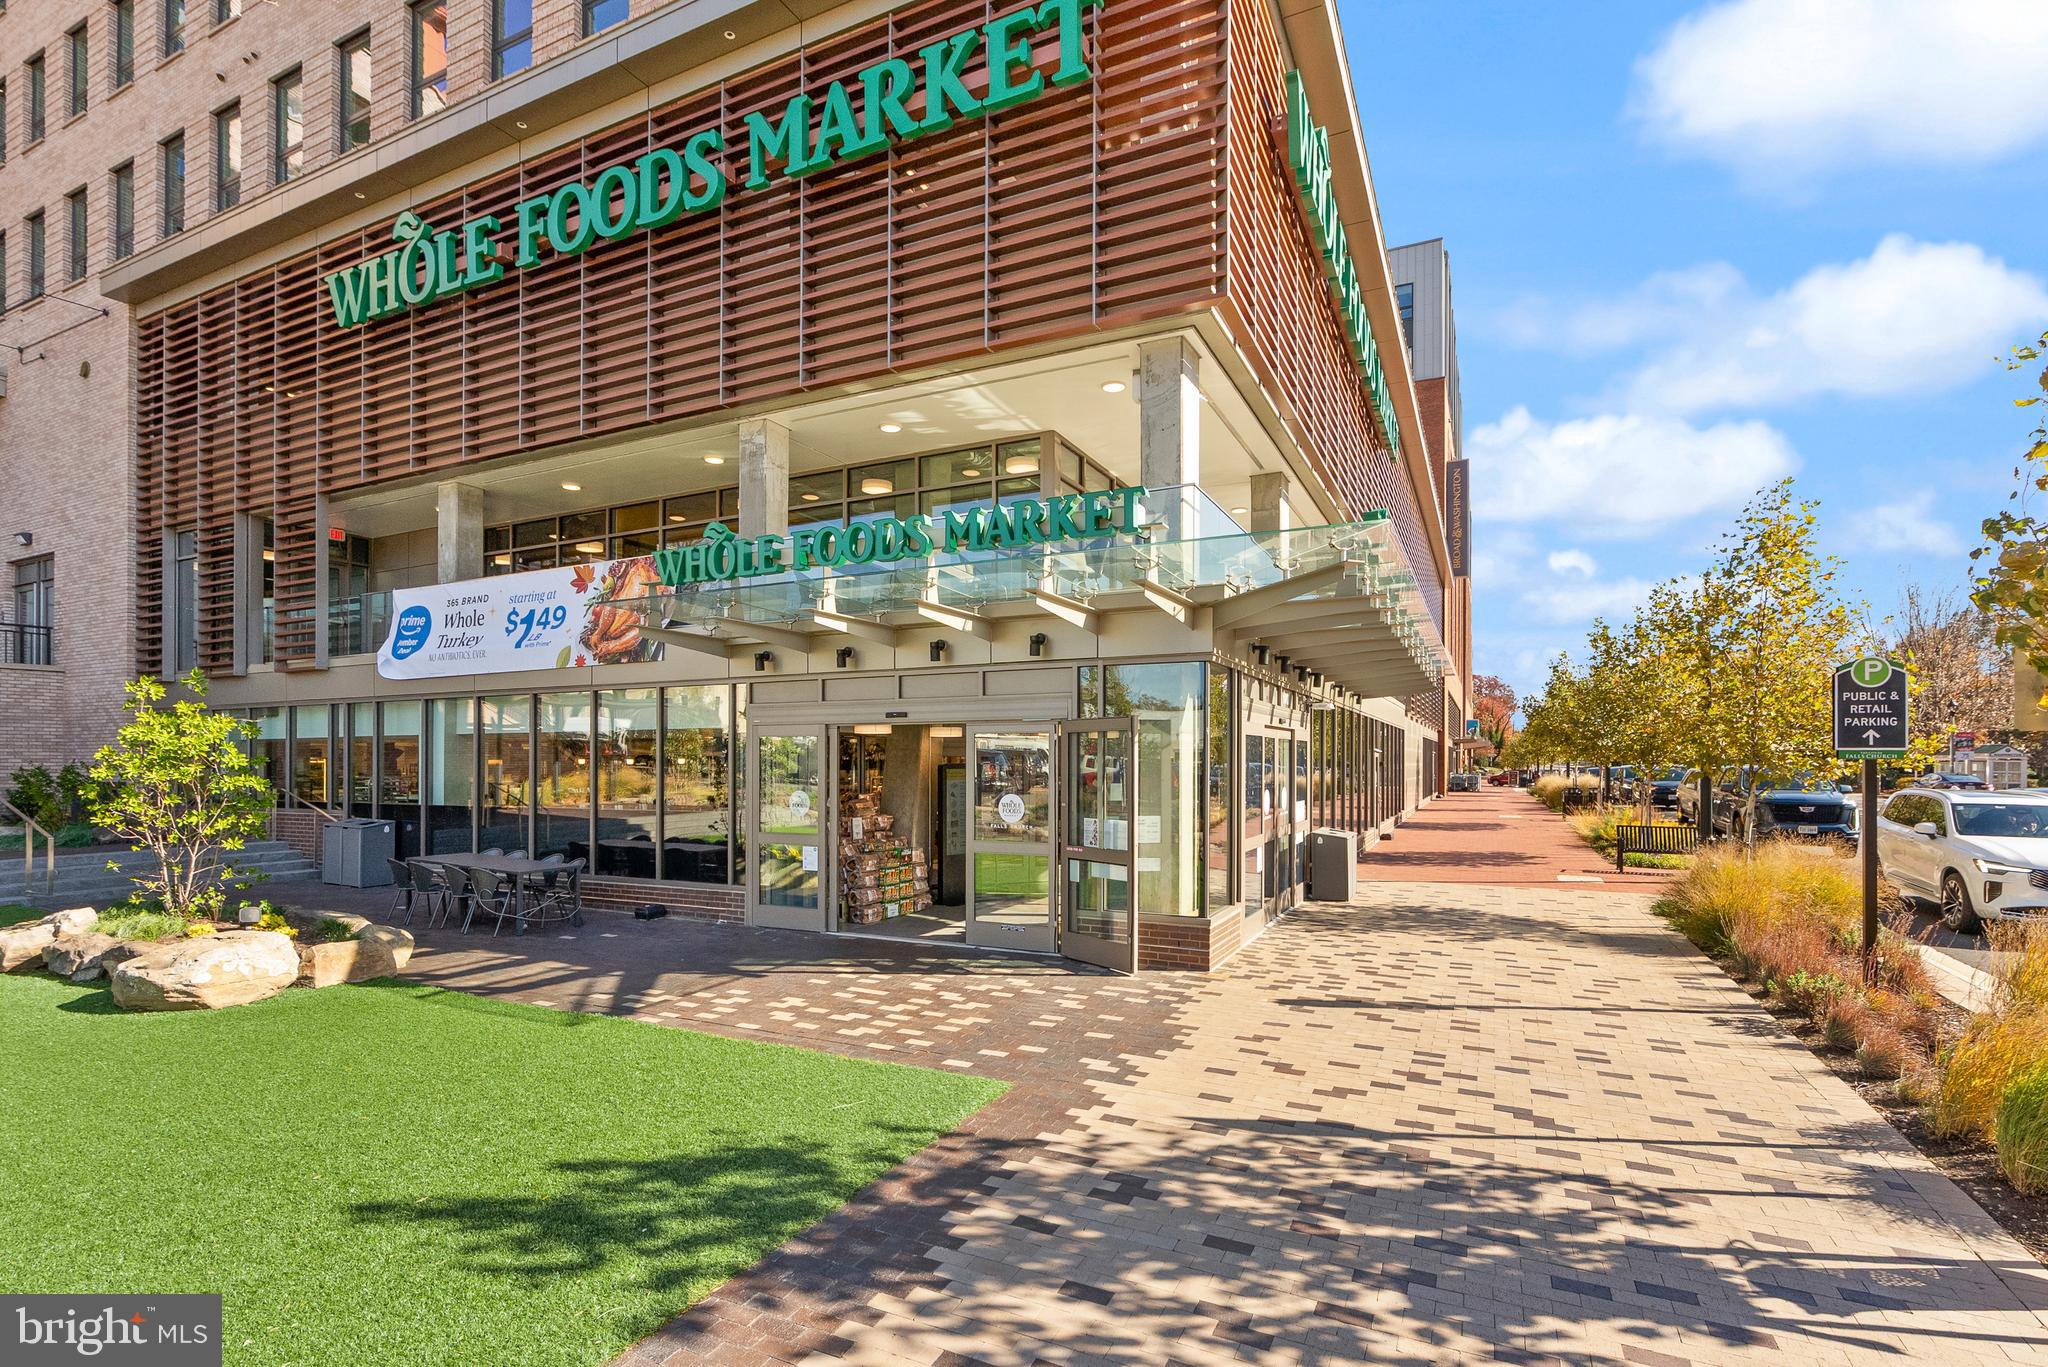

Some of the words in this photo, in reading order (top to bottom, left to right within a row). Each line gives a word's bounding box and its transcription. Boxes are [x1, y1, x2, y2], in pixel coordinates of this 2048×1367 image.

[324, 211, 504, 329] WHOLE
[514, 129, 727, 268] FOODS
[744, 0, 1103, 191] MARKET
[1290, 69, 1349, 298] WHOLE
[1453, 468, 1461, 527] WASHINGTON
[652, 521, 784, 586] WHOLE
[792, 514, 933, 571] FOODS
[943, 486, 1150, 553] MARKET
[446, 599, 459, 608] 365
[461, 594, 490, 606] BRAND
[508, 591, 546, 605] starting
[546, 590, 557, 600] at
[400, 614, 426, 628] prime
[444, 609, 485, 629] Whole
[437, 632, 485, 649] Turkey
[1864, 661, 1883, 681] P
[1843, 691, 1887, 701] PUBLIC
[1890, 691, 1900, 700] &
[1850, 704, 1892, 714] RETAIL
[1844, 717, 1898, 727] PARKING
[1001, 800, 1022, 808] WHOLE
